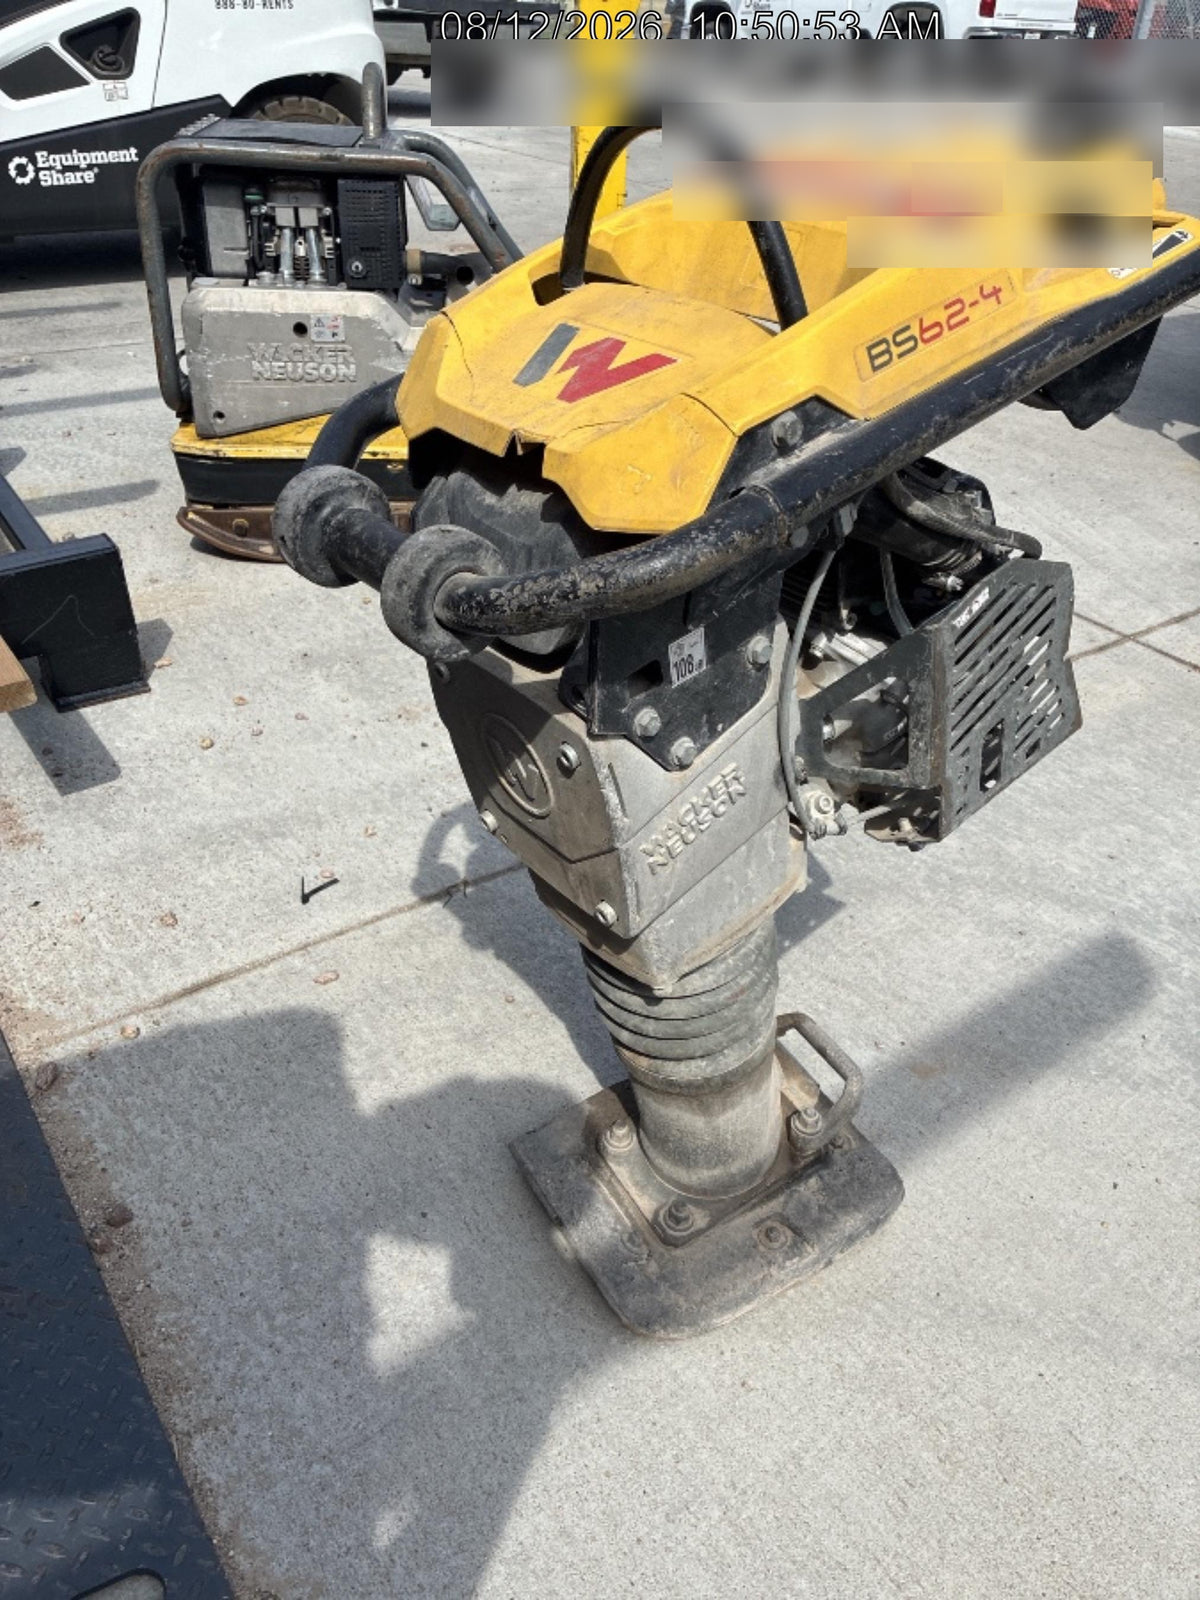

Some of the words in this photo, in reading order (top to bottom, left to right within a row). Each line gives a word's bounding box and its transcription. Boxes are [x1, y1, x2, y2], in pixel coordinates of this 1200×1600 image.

[35, 146, 139, 168] Equipment
[247, 342, 356, 361] WACKER
[866, 284, 1002, 372] BS62-4
[251, 360, 357, 382] NEUSON
[640, 762, 742, 857] WACKER
[647, 777, 747, 876] NEUSON
